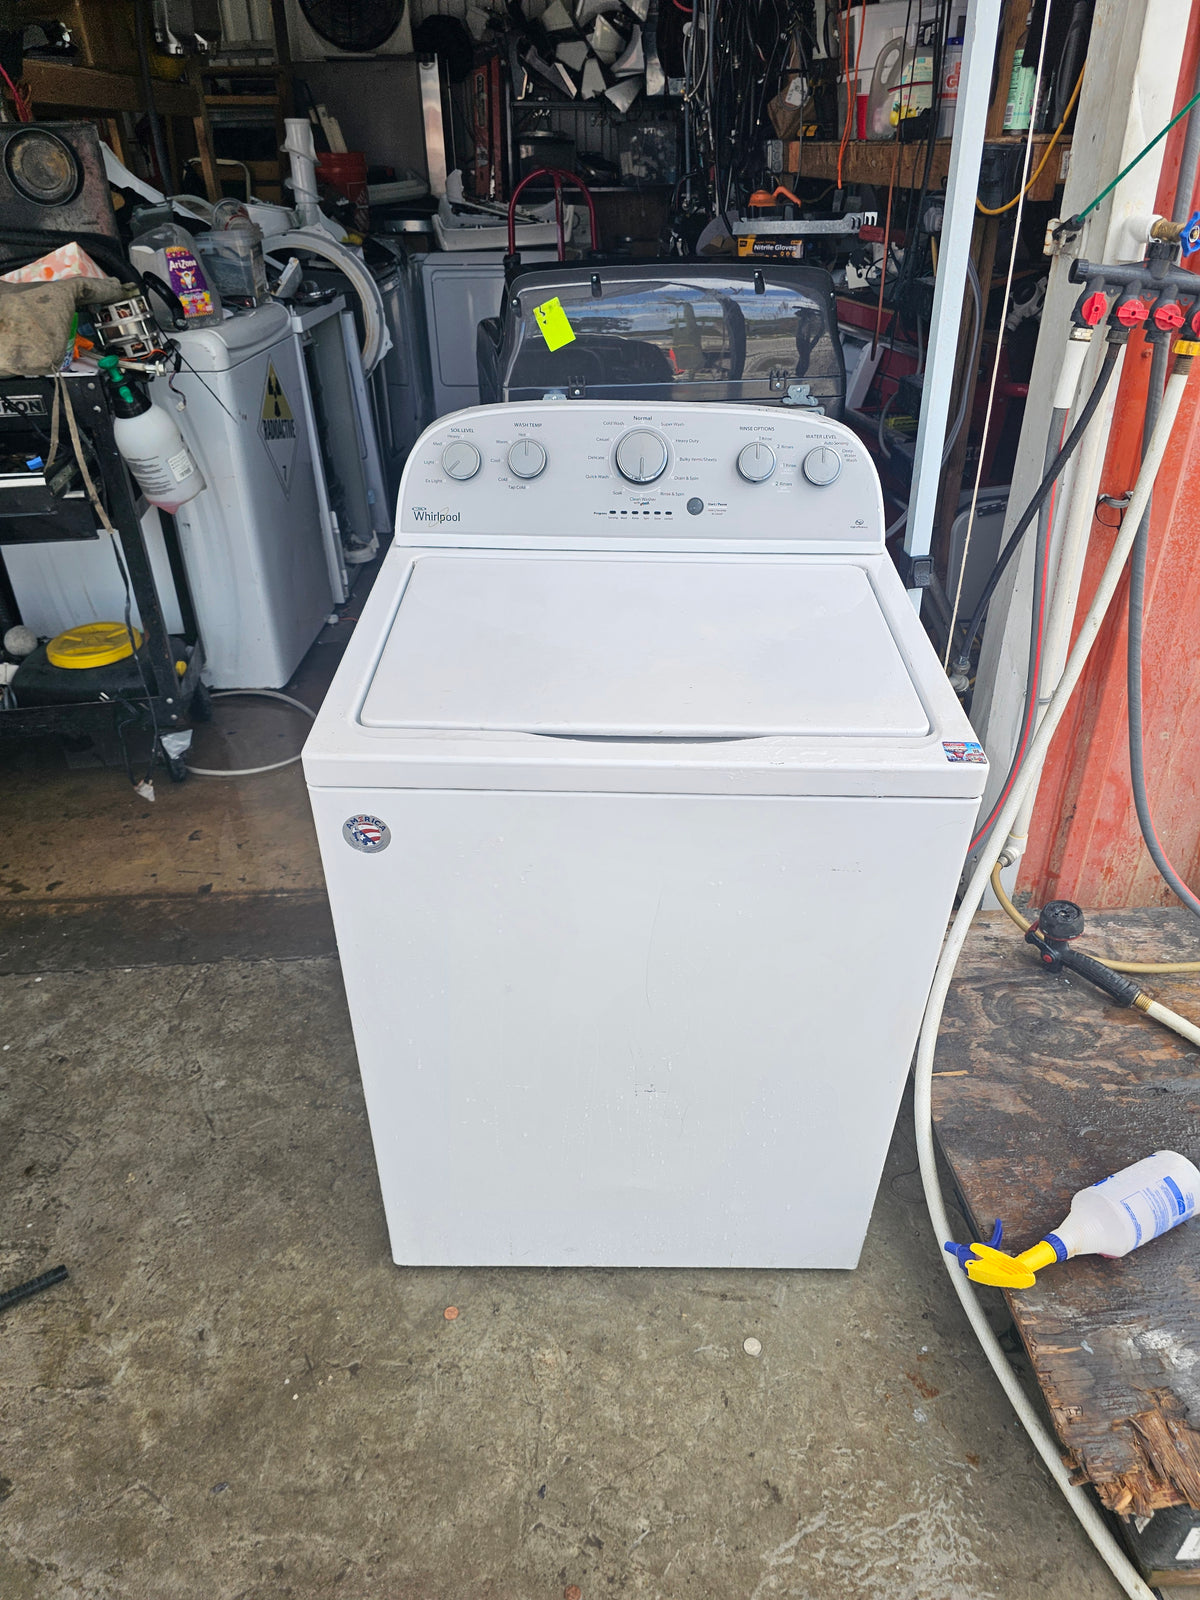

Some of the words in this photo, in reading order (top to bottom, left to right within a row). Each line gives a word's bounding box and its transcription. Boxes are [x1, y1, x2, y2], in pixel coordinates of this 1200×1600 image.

[262, 418, 297, 440] RADIOACTIVE
[413, 511, 461, 524] Whirlpool
[346, 816, 386, 831] AMERICA
